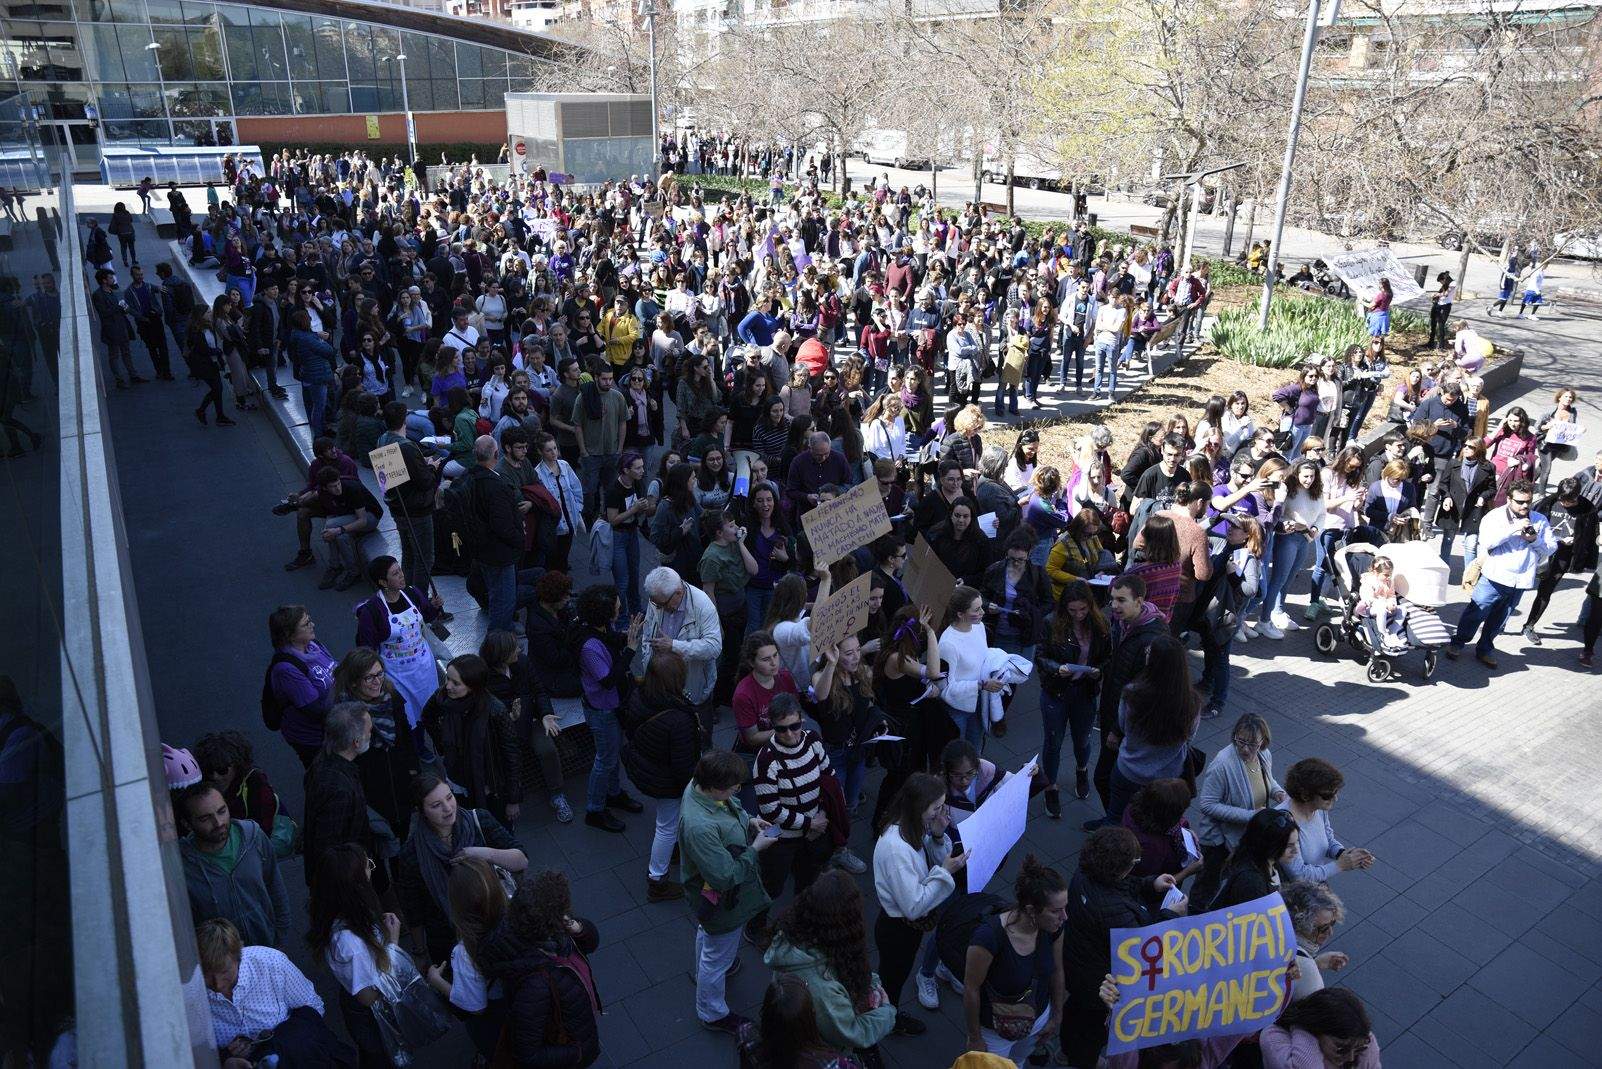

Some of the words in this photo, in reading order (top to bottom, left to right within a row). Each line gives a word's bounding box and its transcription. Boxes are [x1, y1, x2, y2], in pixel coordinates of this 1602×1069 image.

[818, 487, 864, 515] FEMINISMO
[811, 513, 842, 536] NUNCA
[845, 504, 858, 517] HA
[814, 519, 855, 546] MATADO
[815, 549, 826, 559] EL
[827, 524, 868, 550] MACHISMO
[1114, 967, 1287, 1042] GERMANES
